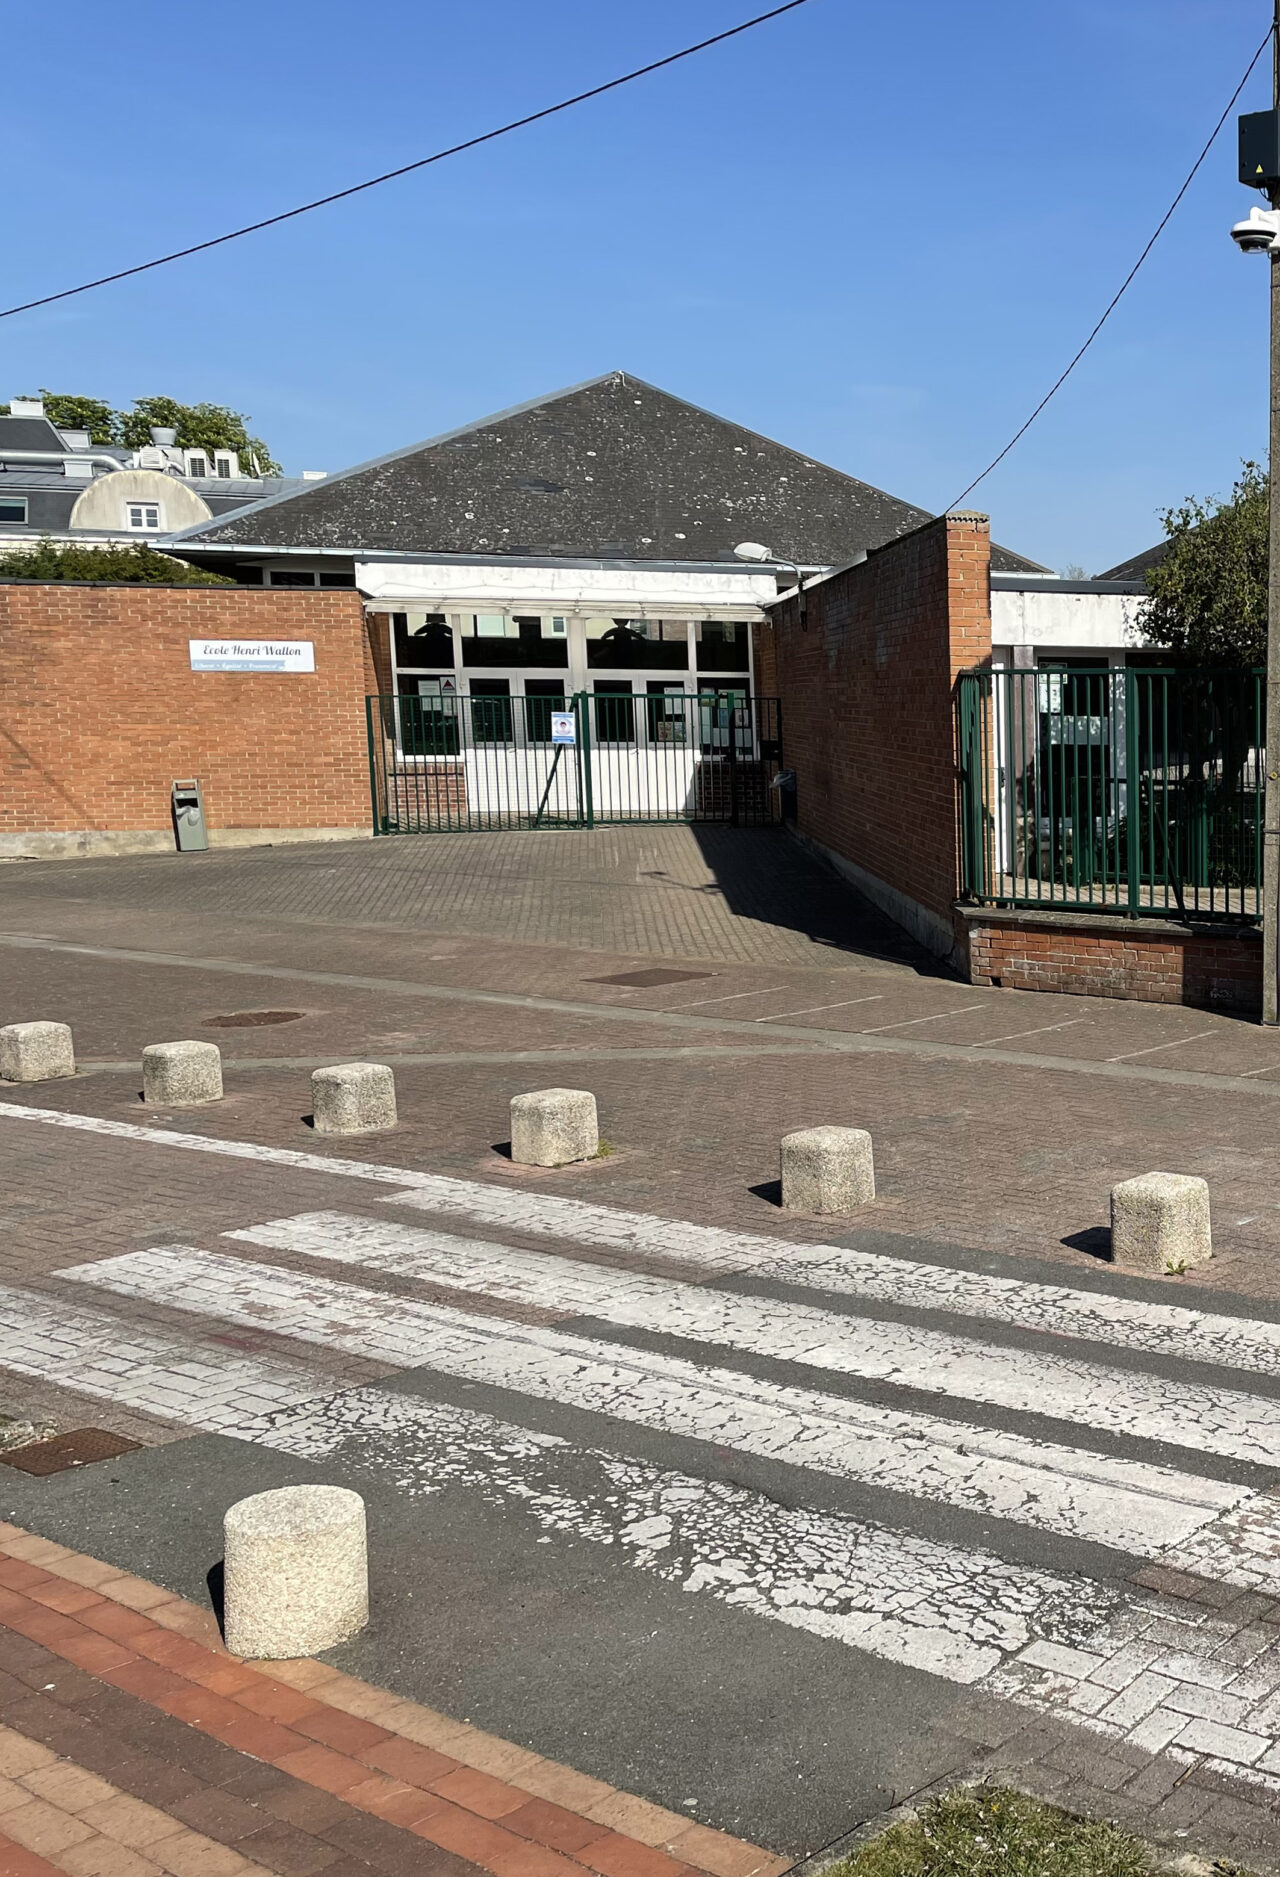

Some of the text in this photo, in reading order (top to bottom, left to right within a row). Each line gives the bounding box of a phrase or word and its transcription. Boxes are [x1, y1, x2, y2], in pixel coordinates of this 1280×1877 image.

[203, 645, 301, 656] Ecole Henri Wallon
